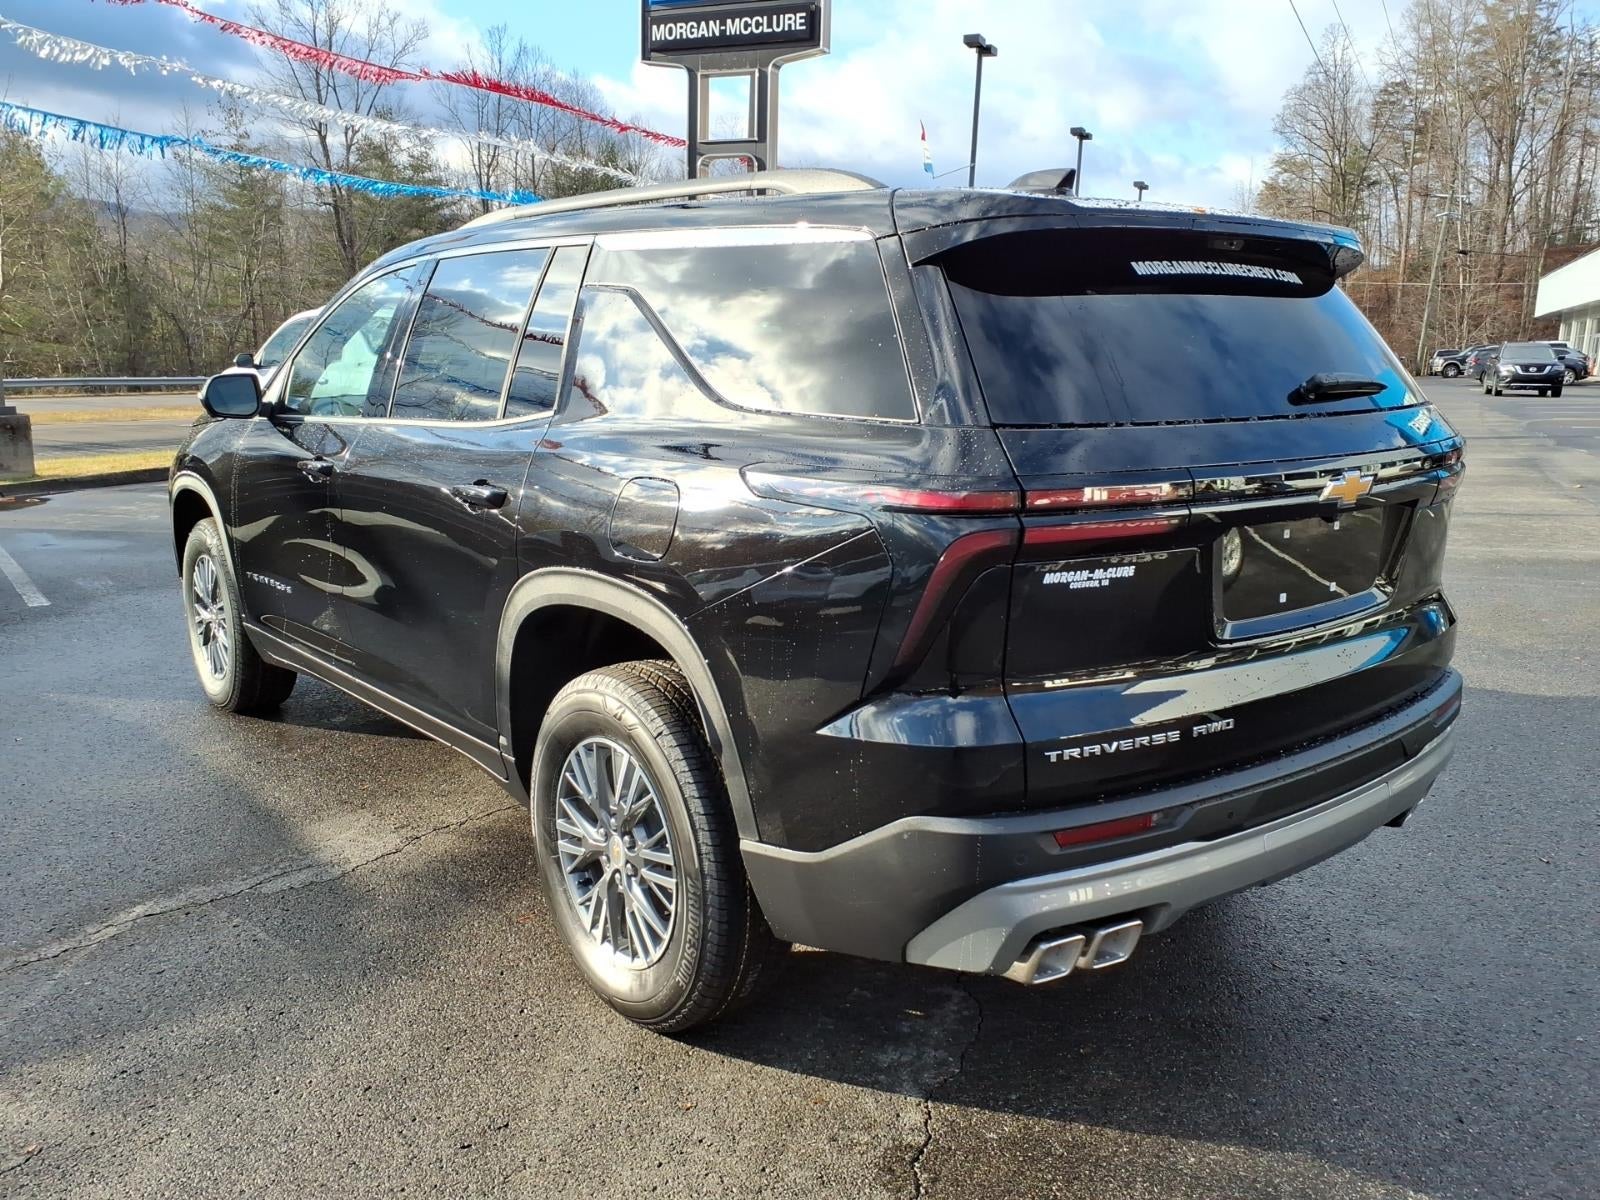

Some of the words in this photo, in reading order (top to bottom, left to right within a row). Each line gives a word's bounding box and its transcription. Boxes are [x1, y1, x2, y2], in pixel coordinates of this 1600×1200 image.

[651, 12, 807, 41] MORGAN-MCCLURE
[1130, 260, 1303, 285] MORGANMCCLURECHEVY.COM
[1044, 730, 1181, 763] TRAVERSE
[1192, 718, 1235, 738] AWD
